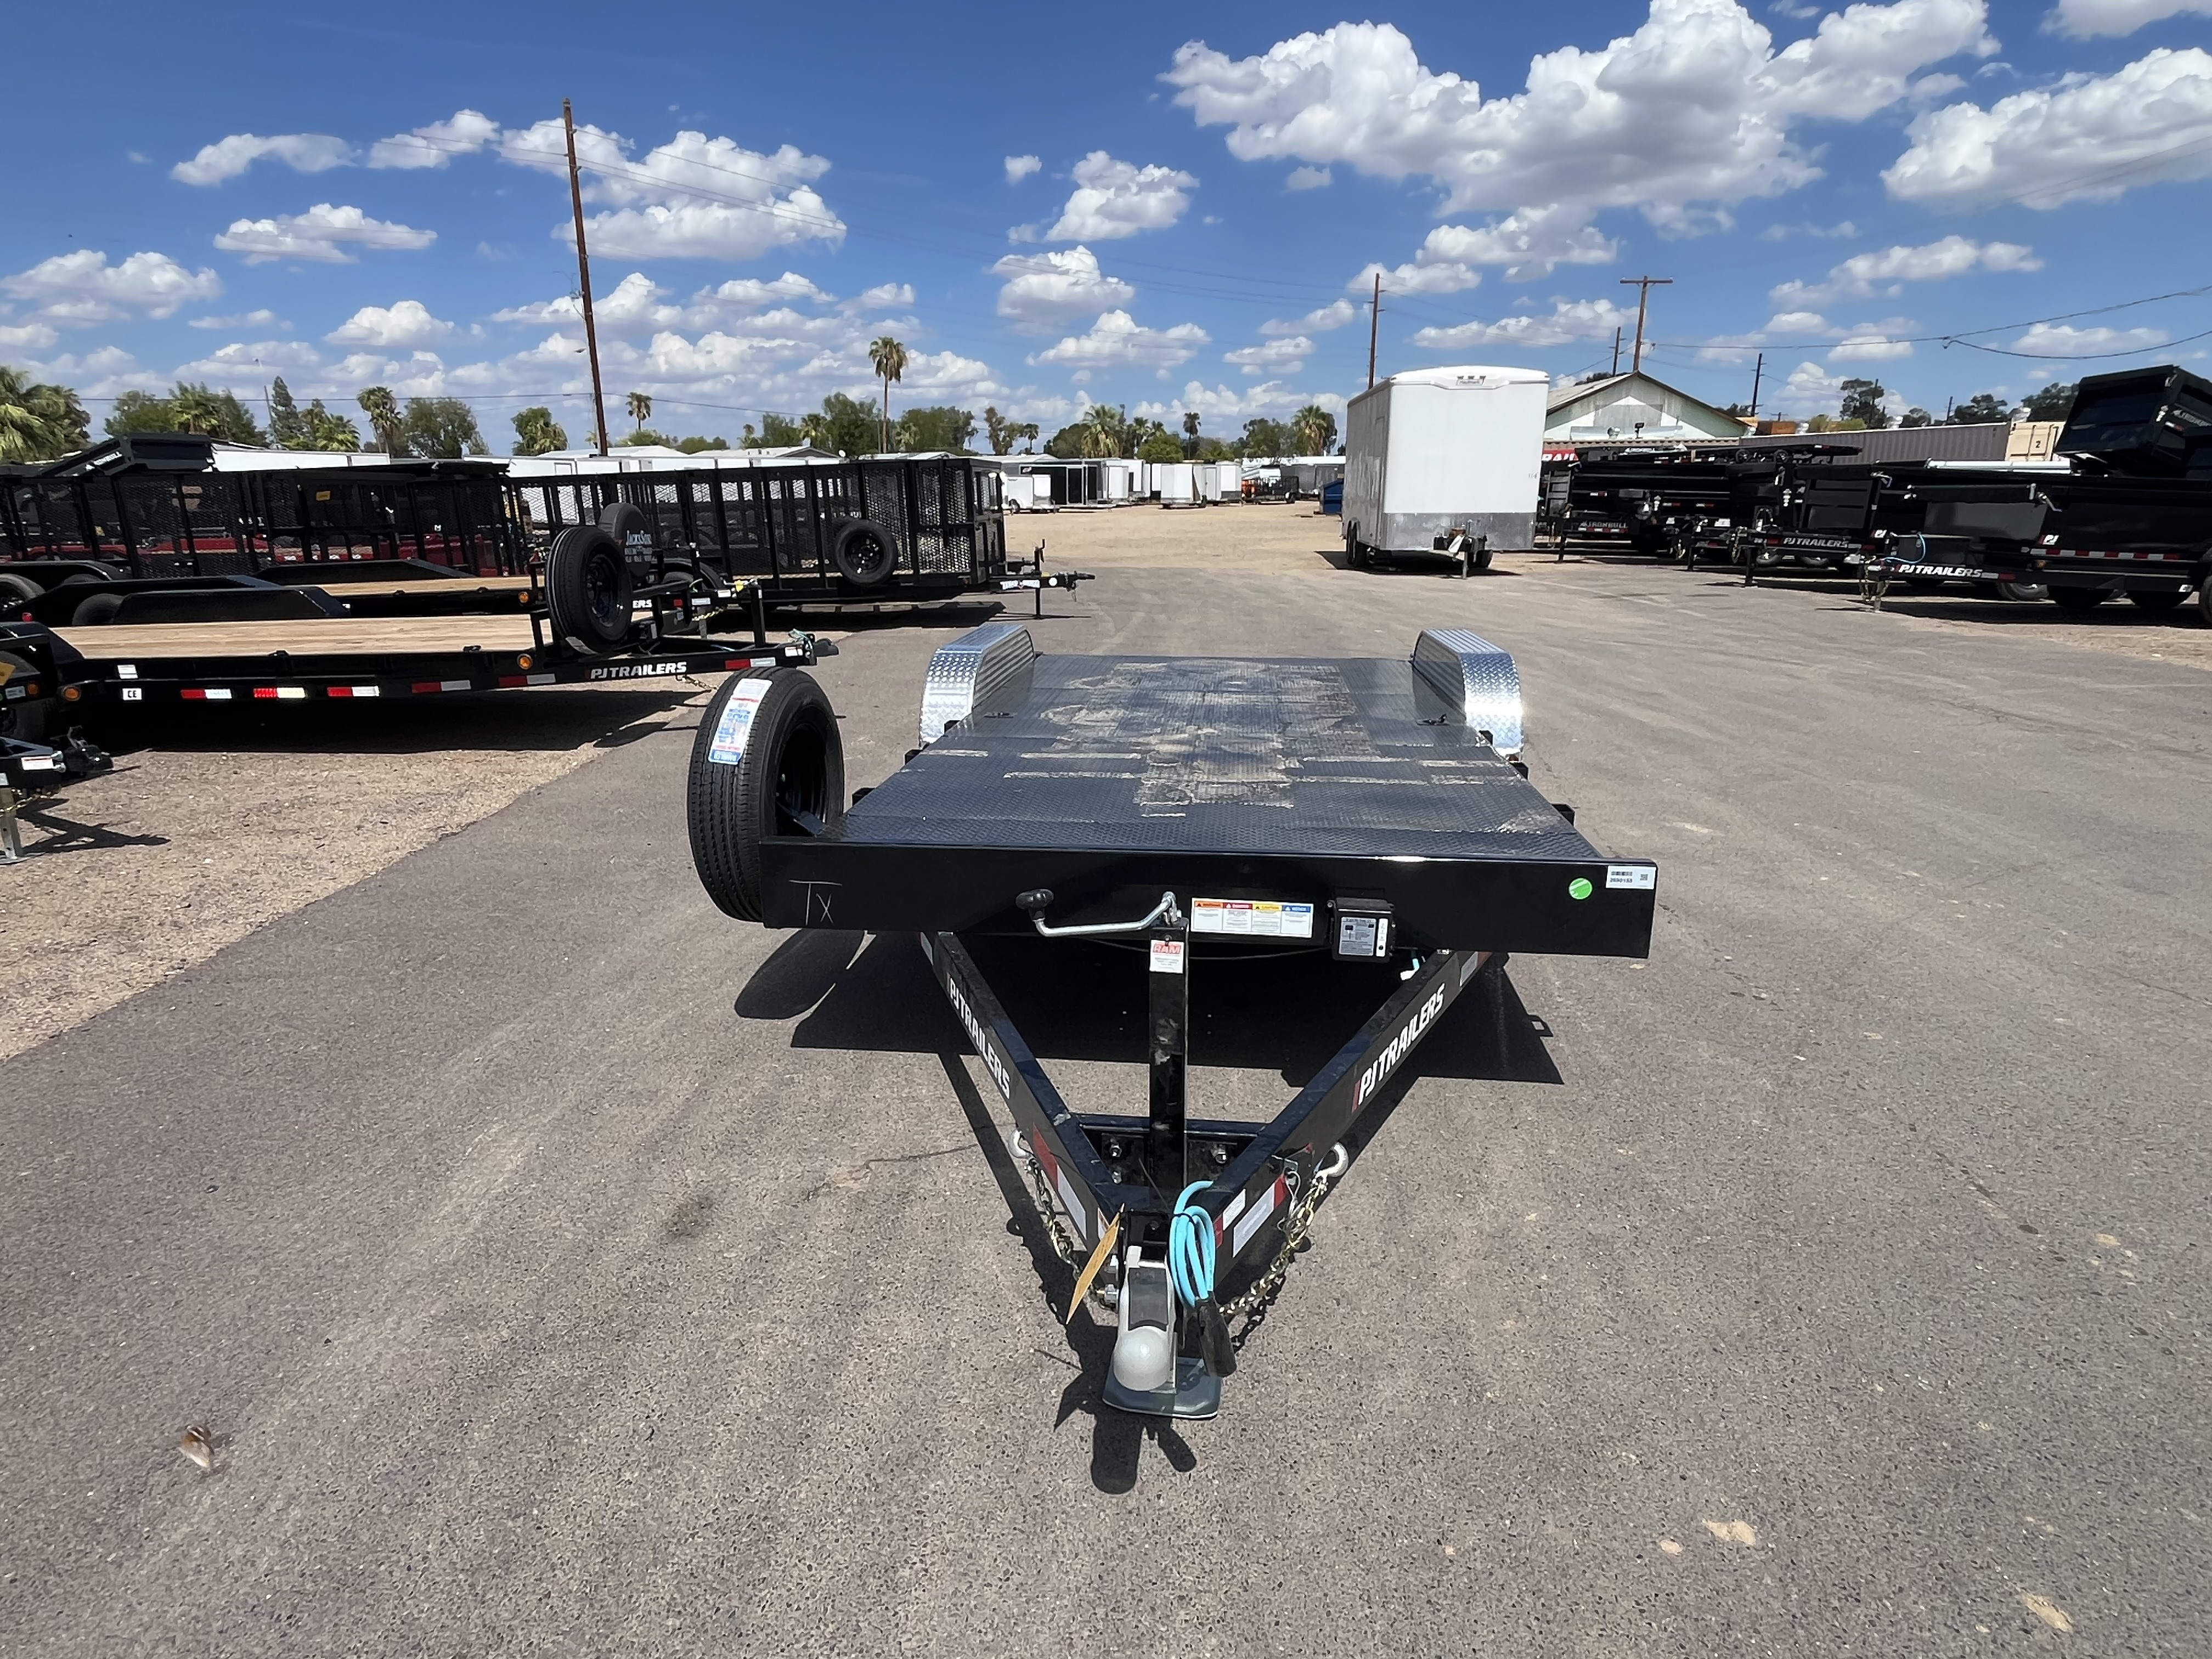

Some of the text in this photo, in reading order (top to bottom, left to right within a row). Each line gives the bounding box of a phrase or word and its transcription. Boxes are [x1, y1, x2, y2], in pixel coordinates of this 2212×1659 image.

[2035, 441, 2041, 449] 2
[1796, 538, 1849, 548] TRAILERS
[2042, 534, 2059, 545] PJ
[1898, 564, 1983, 578] PJ TRAILERS
[590, 662, 687, 679] PJ TRAILERS
[127, 690, 137, 698] CE
[1153, 944, 1182, 955] RAM
[950, 977, 1010, 1099] PJ TRAILERS
[1358, 983, 1445, 1106] PJ TRAILERS
